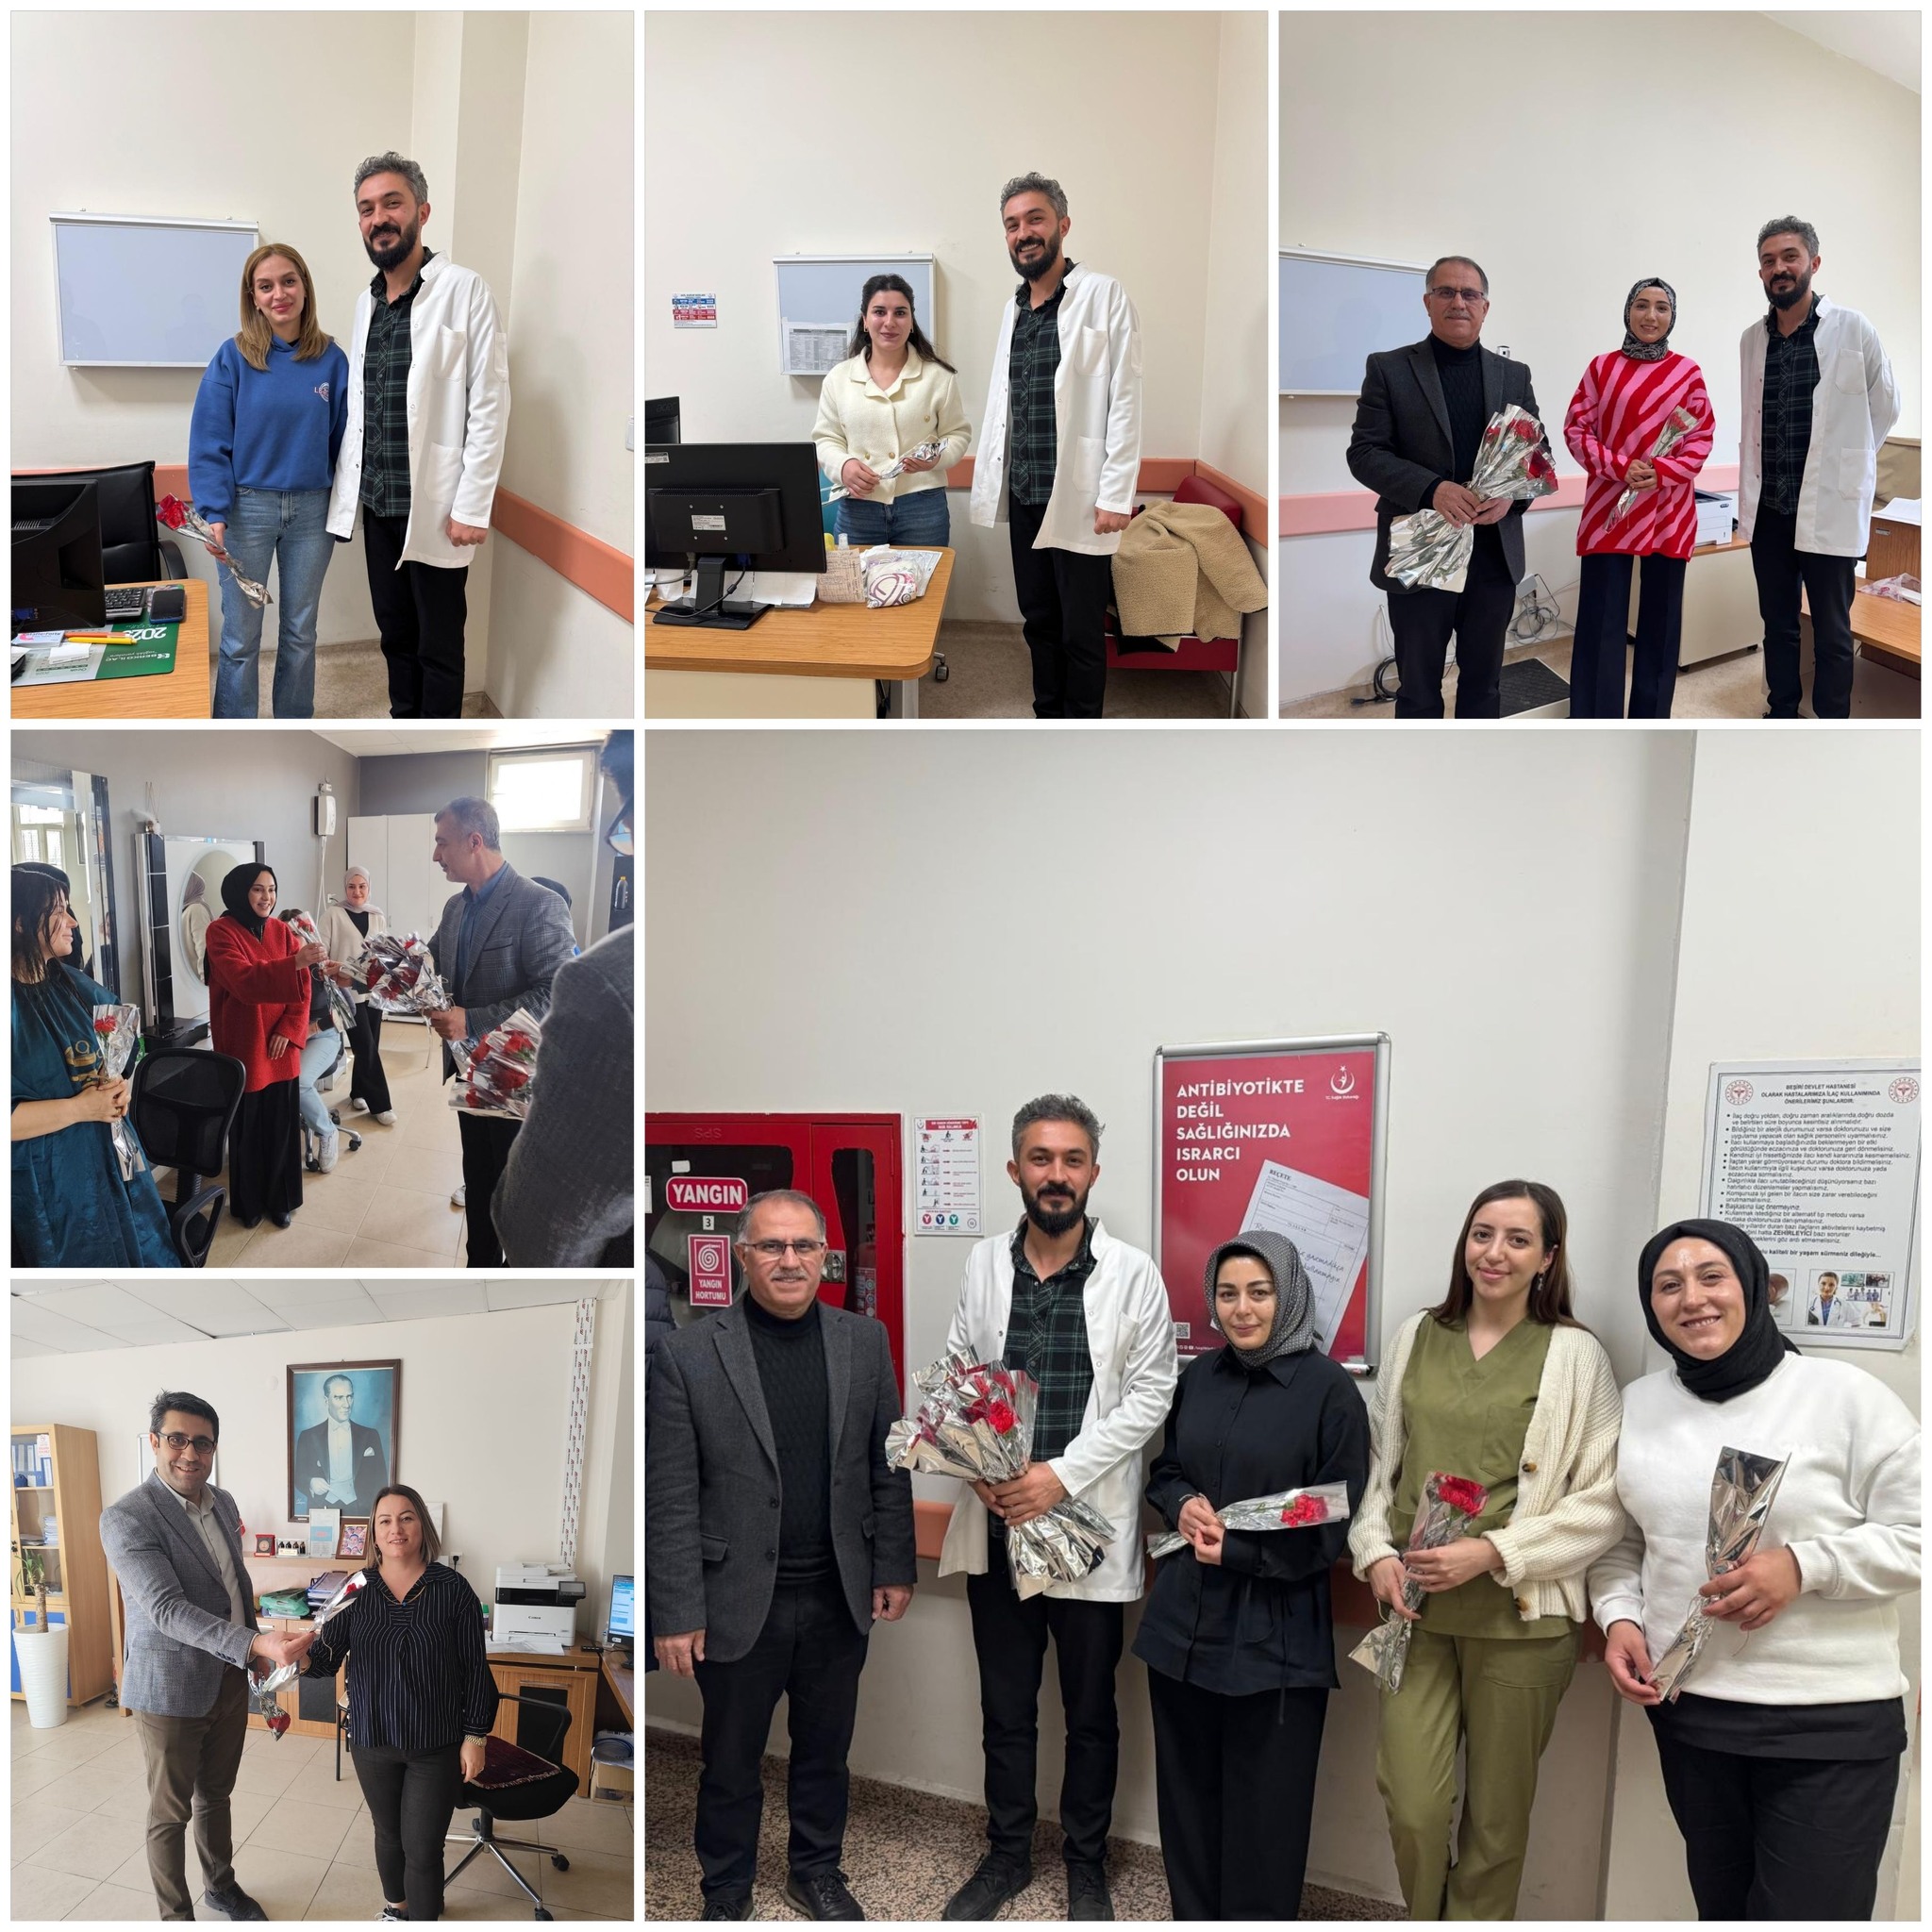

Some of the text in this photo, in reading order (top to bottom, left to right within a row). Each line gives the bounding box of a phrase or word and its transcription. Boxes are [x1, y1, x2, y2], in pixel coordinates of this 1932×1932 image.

[1176, 1077, 1305, 1098] ANTİBİYOTİKTE
[1177, 1101, 1224, 1118] DEĞİL
[1176, 1122, 1291, 1140] SAĞLIĞINIZDA
[1176, 1146, 1240, 1160] ISRARCI
[1176, 1168, 1220, 1181] OLUN
[1269, 1169, 1292, 1181] REÇETE
[672, 1184, 742, 1205] YANGIN
[706, 1218, 711, 1227] 3
[698, 1279, 723, 1289] YANGIN
[695, 1291, 726, 1300] HORTUMU
